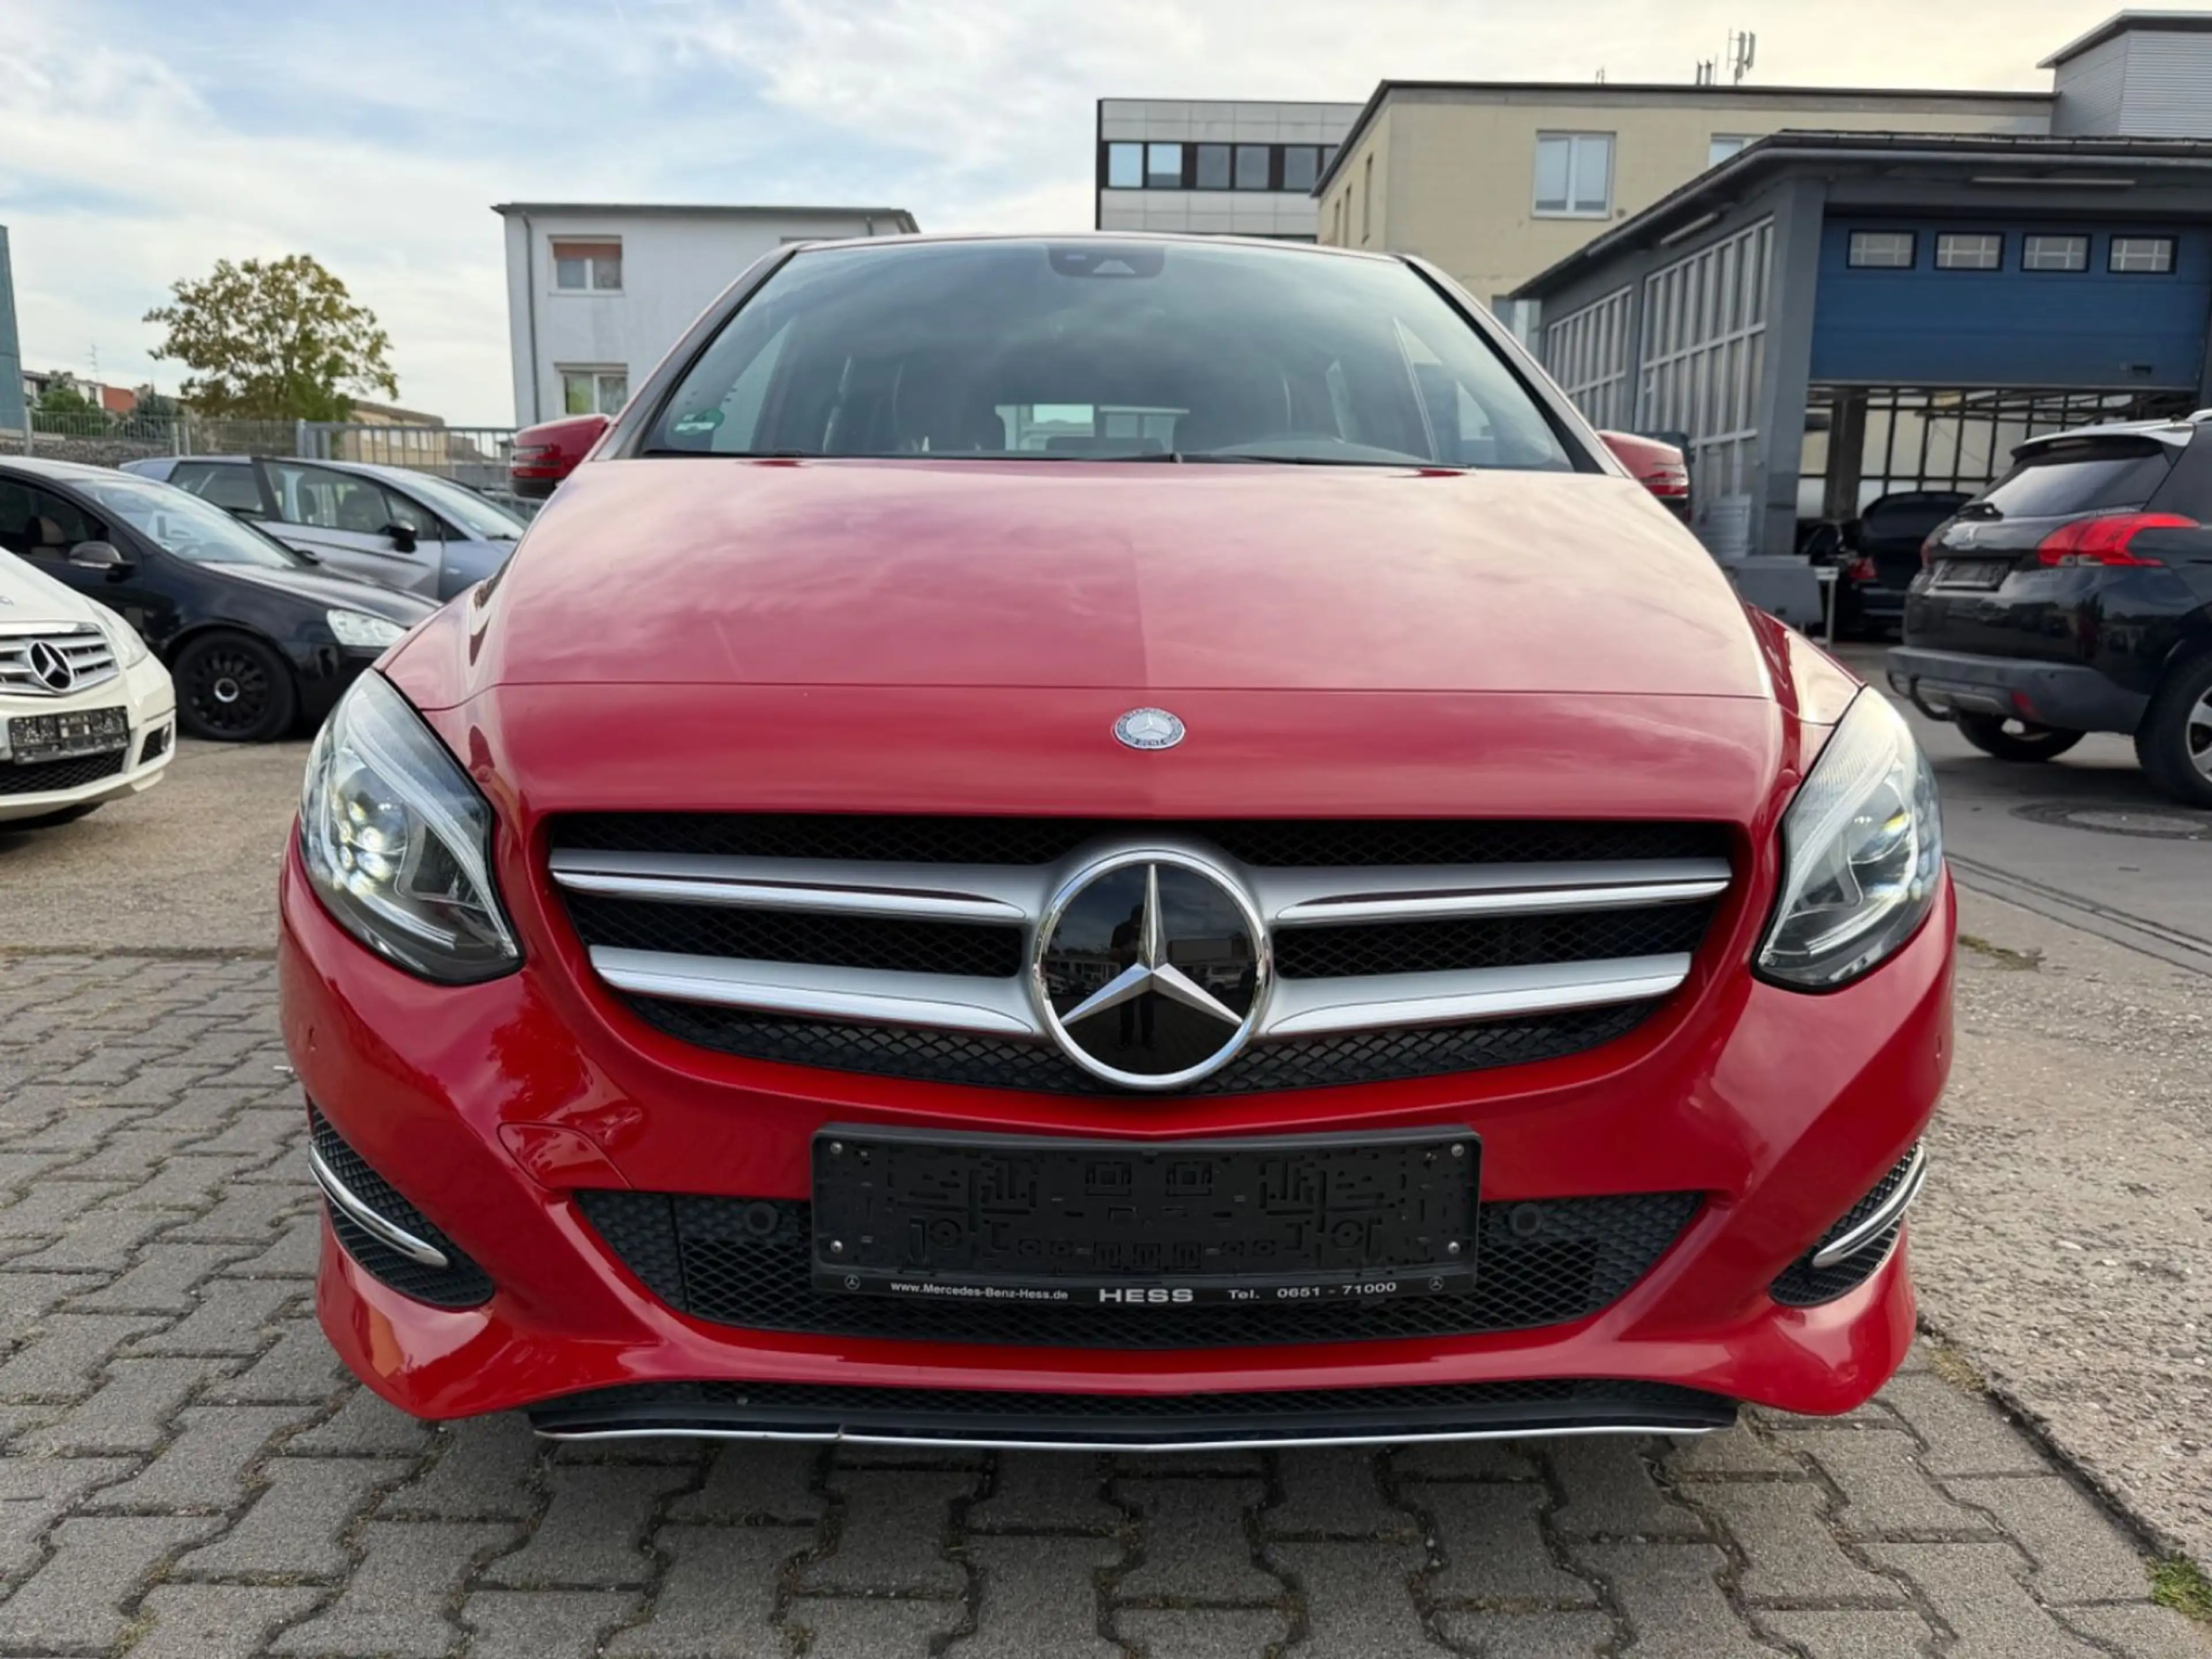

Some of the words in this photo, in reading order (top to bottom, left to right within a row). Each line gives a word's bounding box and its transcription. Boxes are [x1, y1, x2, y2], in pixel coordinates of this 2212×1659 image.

[890, 1282, 1069, 1300] www.Mercedes-Benz-Hess.de
[1099, 1289, 1194, 1302] HESS
[1228, 1289, 1260, 1300] Tel.
[1342, 1282, 1397, 1295] 71000
